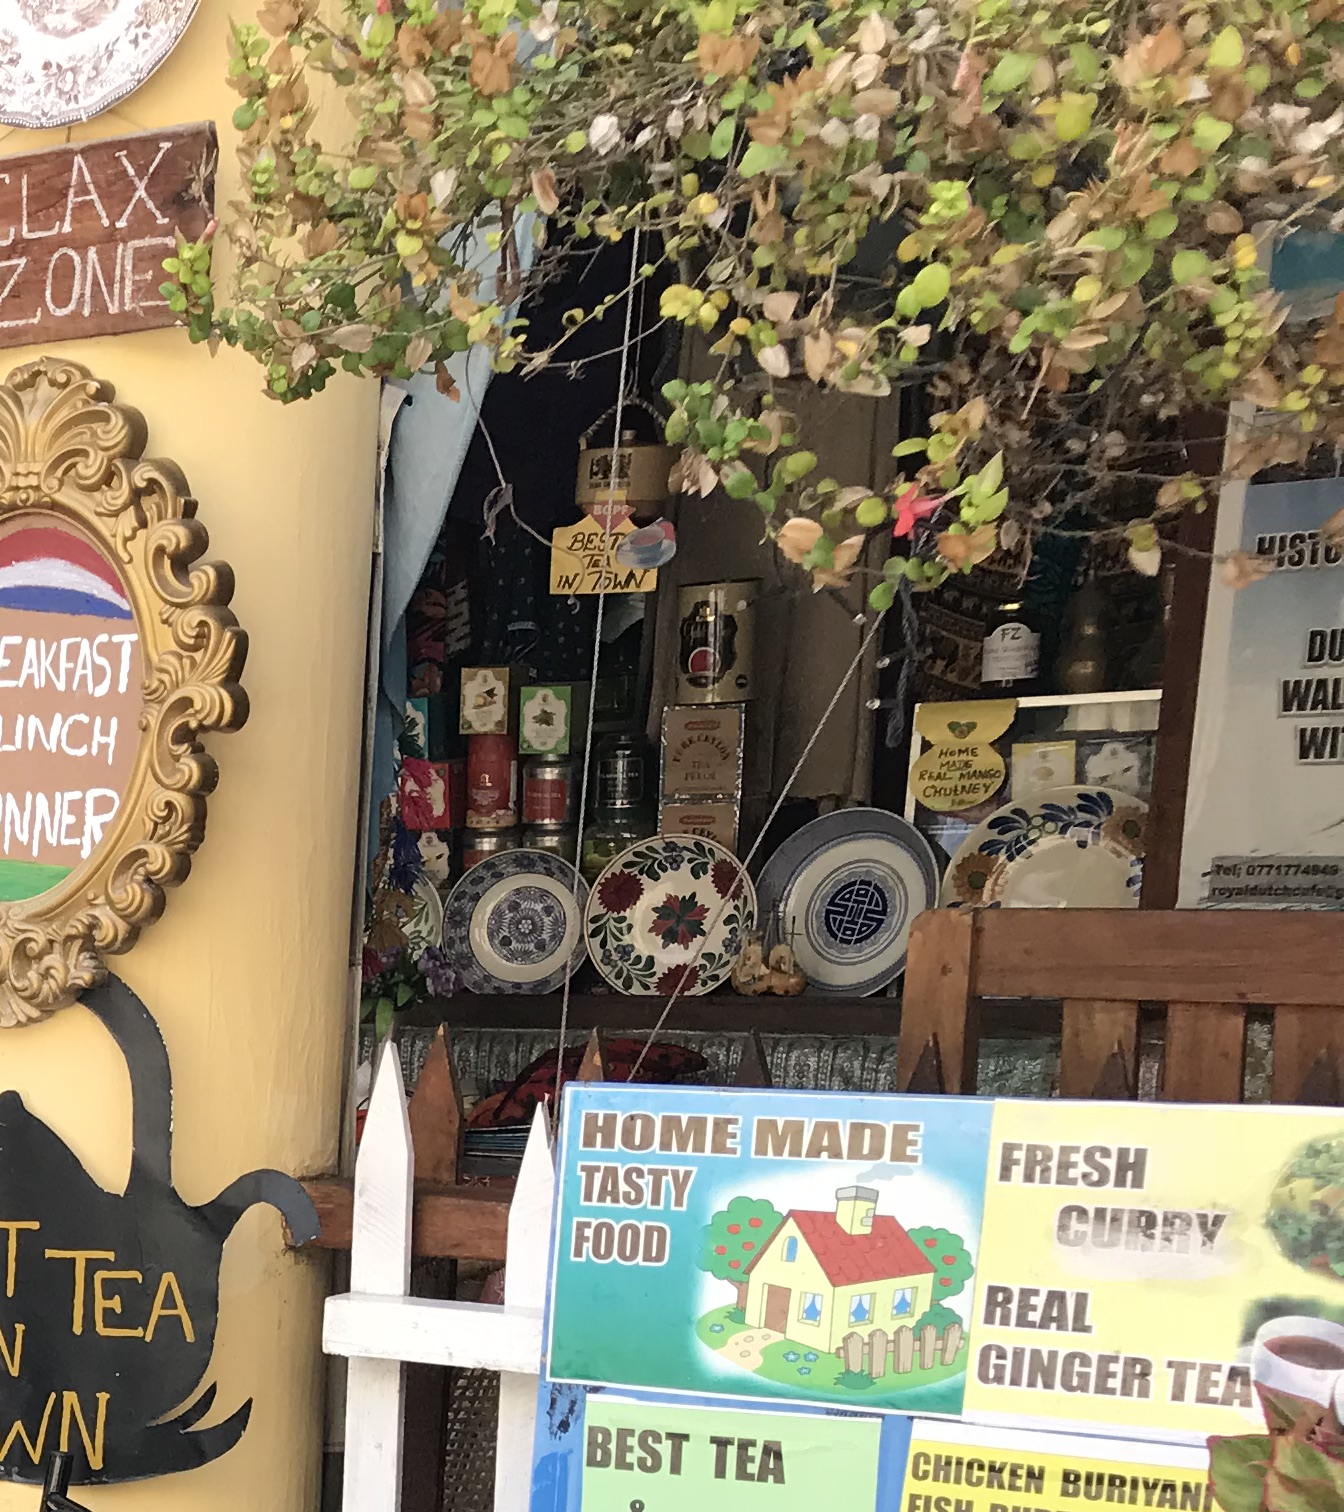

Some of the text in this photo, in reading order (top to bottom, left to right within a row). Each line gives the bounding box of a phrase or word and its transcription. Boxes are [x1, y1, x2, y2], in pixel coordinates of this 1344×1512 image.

[567, 531, 627, 552] BEST
[557, 569, 651, 591] IN TOWN
[1307, 629, 1344, 663] DU
[938, 747, 978, 758] HOME
[939, 760, 973, 769] MADE
[919, 769, 1002, 781] REAL MANGO
[923, 782, 994, 798] CHUTNEY
[582, 1112, 923, 1164] HOME MADE
[580, 1165, 693, 1209] TASTY
[999, 1142, 1148, 1190] FRESH
[573, 1221, 667, 1262] FOOD
[1057, 1204, 1227, 1254] CURRY
[45, 1249, 195, 1343] TEA
[983, 1285, 1093, 1333] REAL
[977, 1343, 1254, 1408] GINGER TEA
[586, 1425, 786, 1485] BEST TEA
[912, 1451, 1213, 1512] CHICKEN BURIYANI
